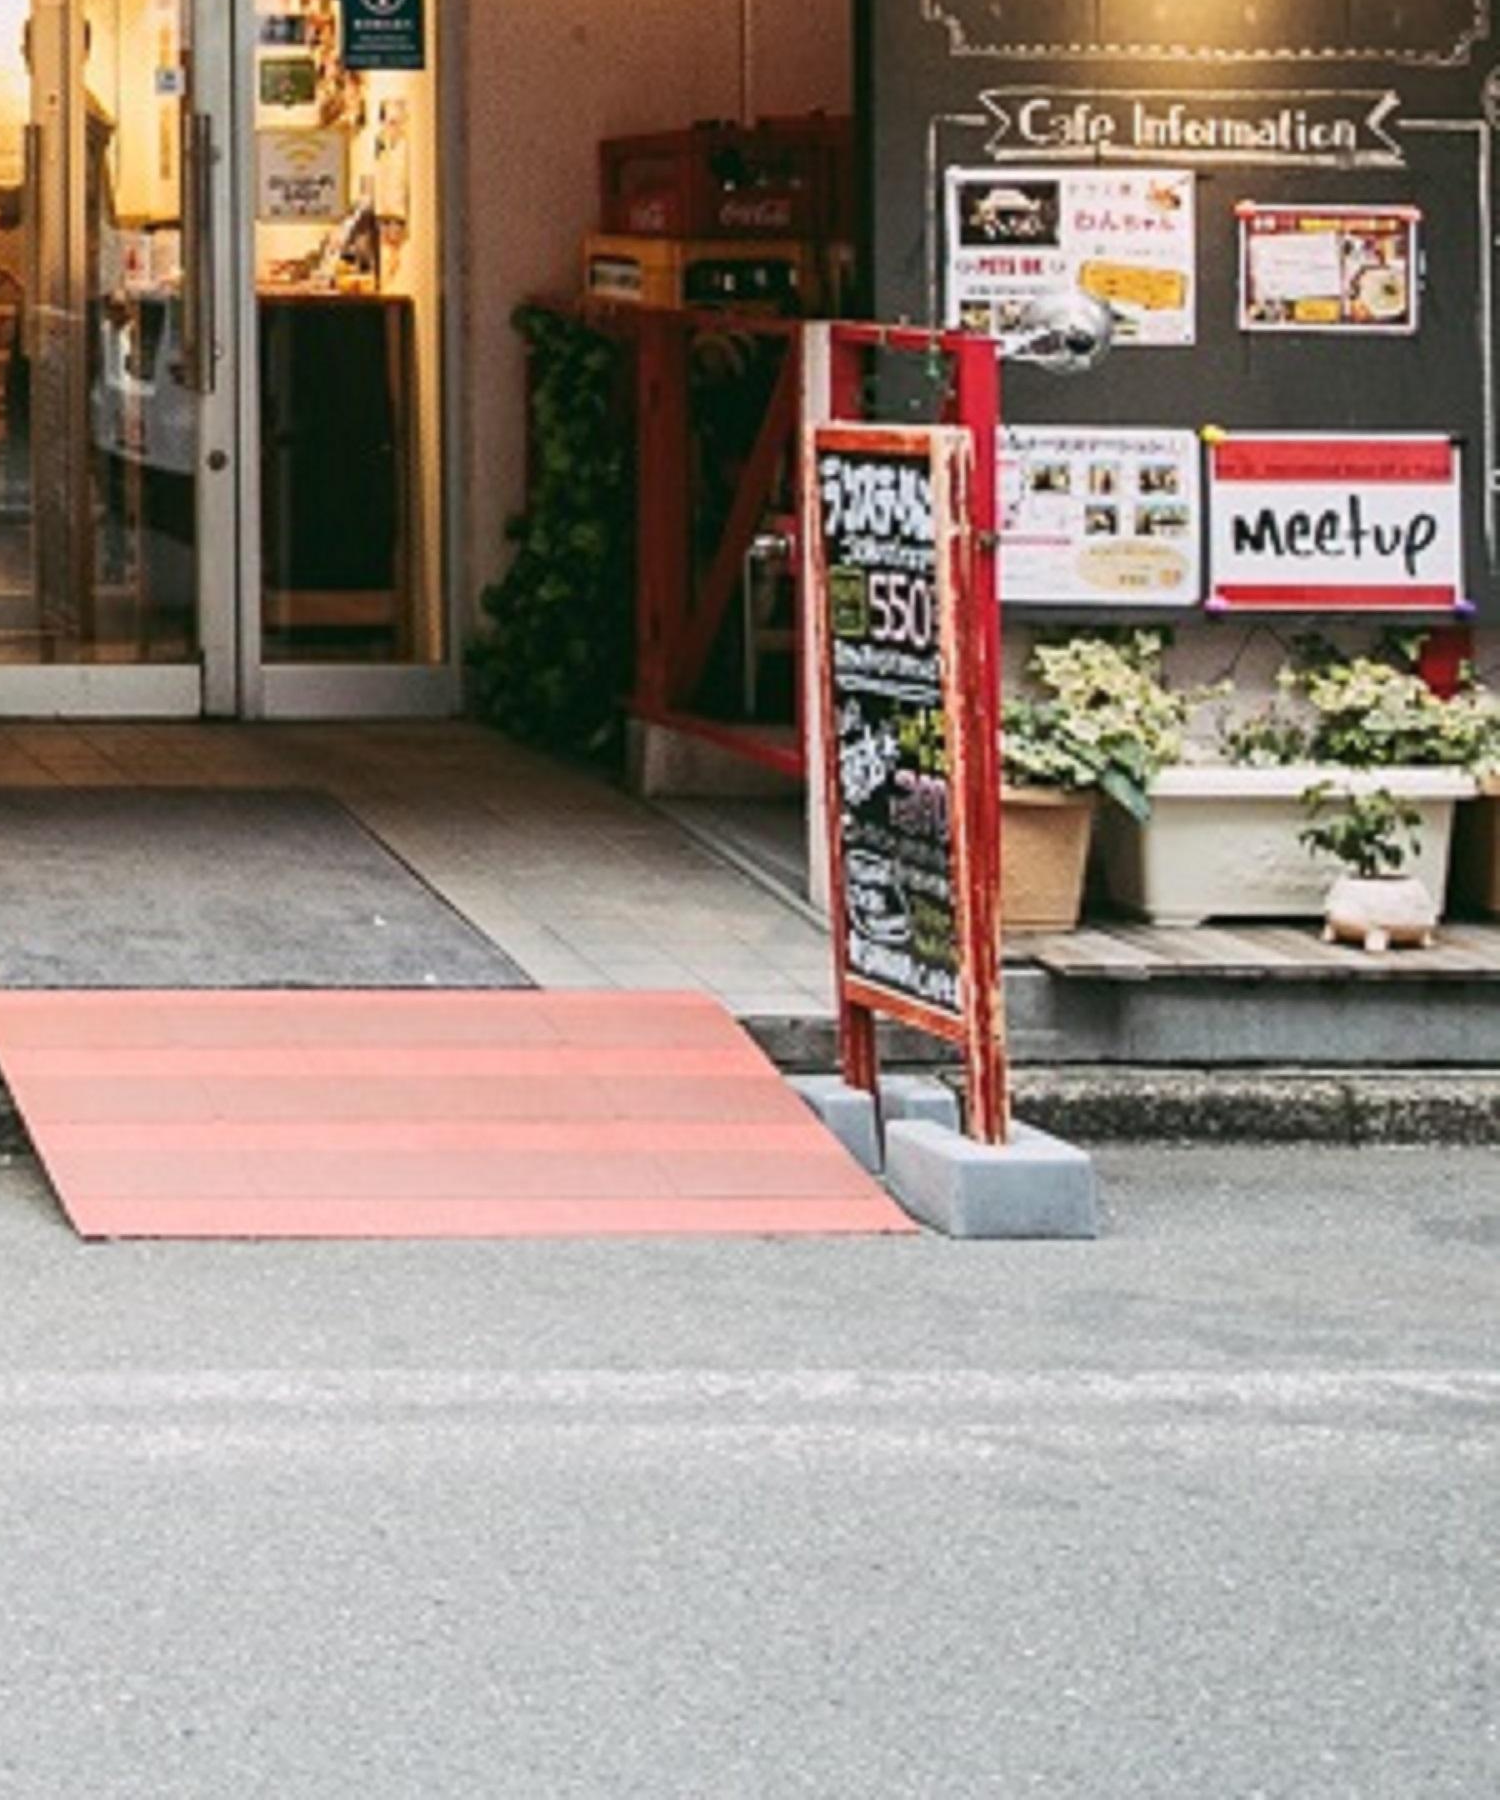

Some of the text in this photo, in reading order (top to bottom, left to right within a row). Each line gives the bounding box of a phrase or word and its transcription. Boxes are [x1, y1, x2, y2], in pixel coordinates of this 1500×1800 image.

[1018, 98, 1358, 150] Cafe Information
[1233, 493, 1437, 577] Meetup
[867, 572, 932, 648] 550
